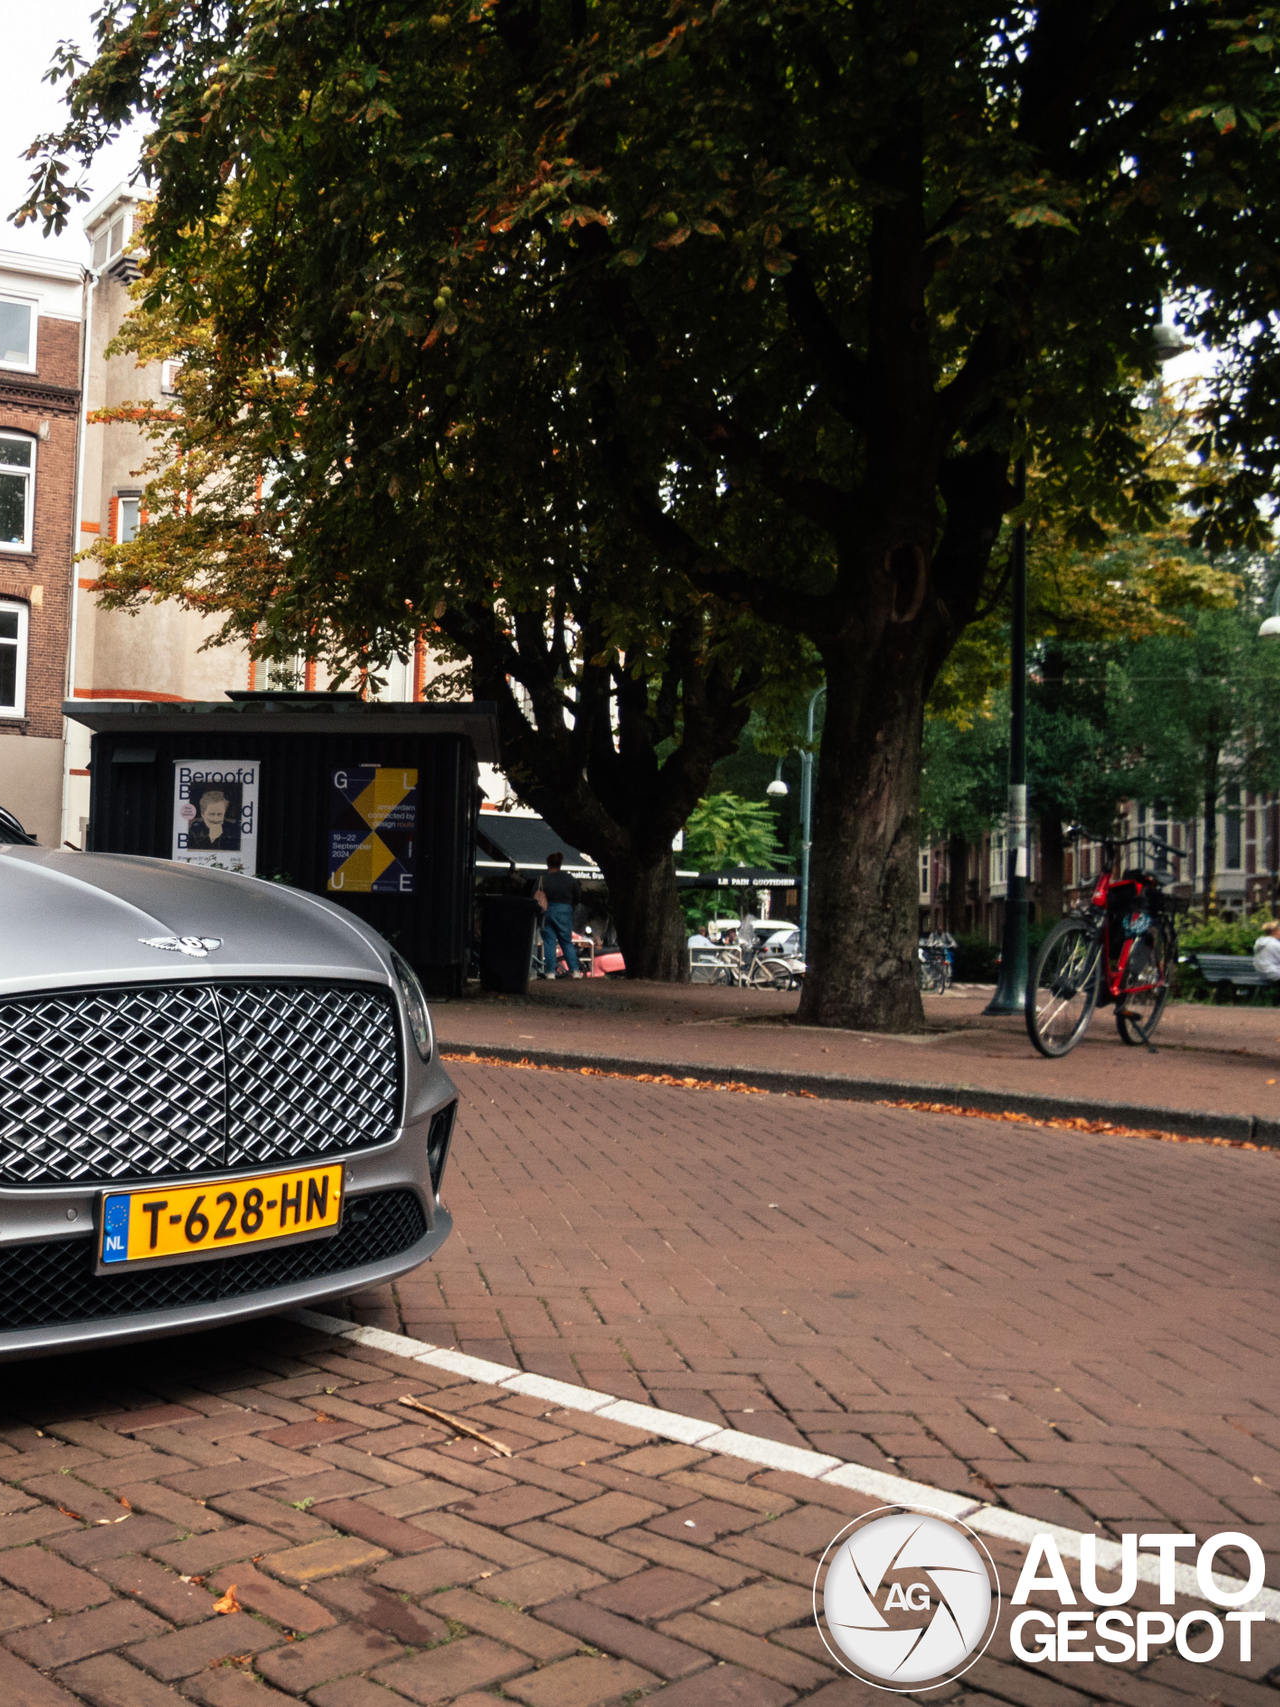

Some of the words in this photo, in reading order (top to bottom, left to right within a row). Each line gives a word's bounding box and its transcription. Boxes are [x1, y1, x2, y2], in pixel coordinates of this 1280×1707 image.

[180, 768, 254, 785] Beroofd
[334, 771, 348, 789] G
[403, 772, 416, 790] L
[372, 821, 396, 829] design
[405, 812, 416, 821] by
[331, 871, 345, 889] U
[399, 873, 413, 892] E
[752, 878, 795, 886] QUOTIDIEN
[106, 1236, 125, 1251] NL
[142, 1175, 329, 1250] T-628-HN
